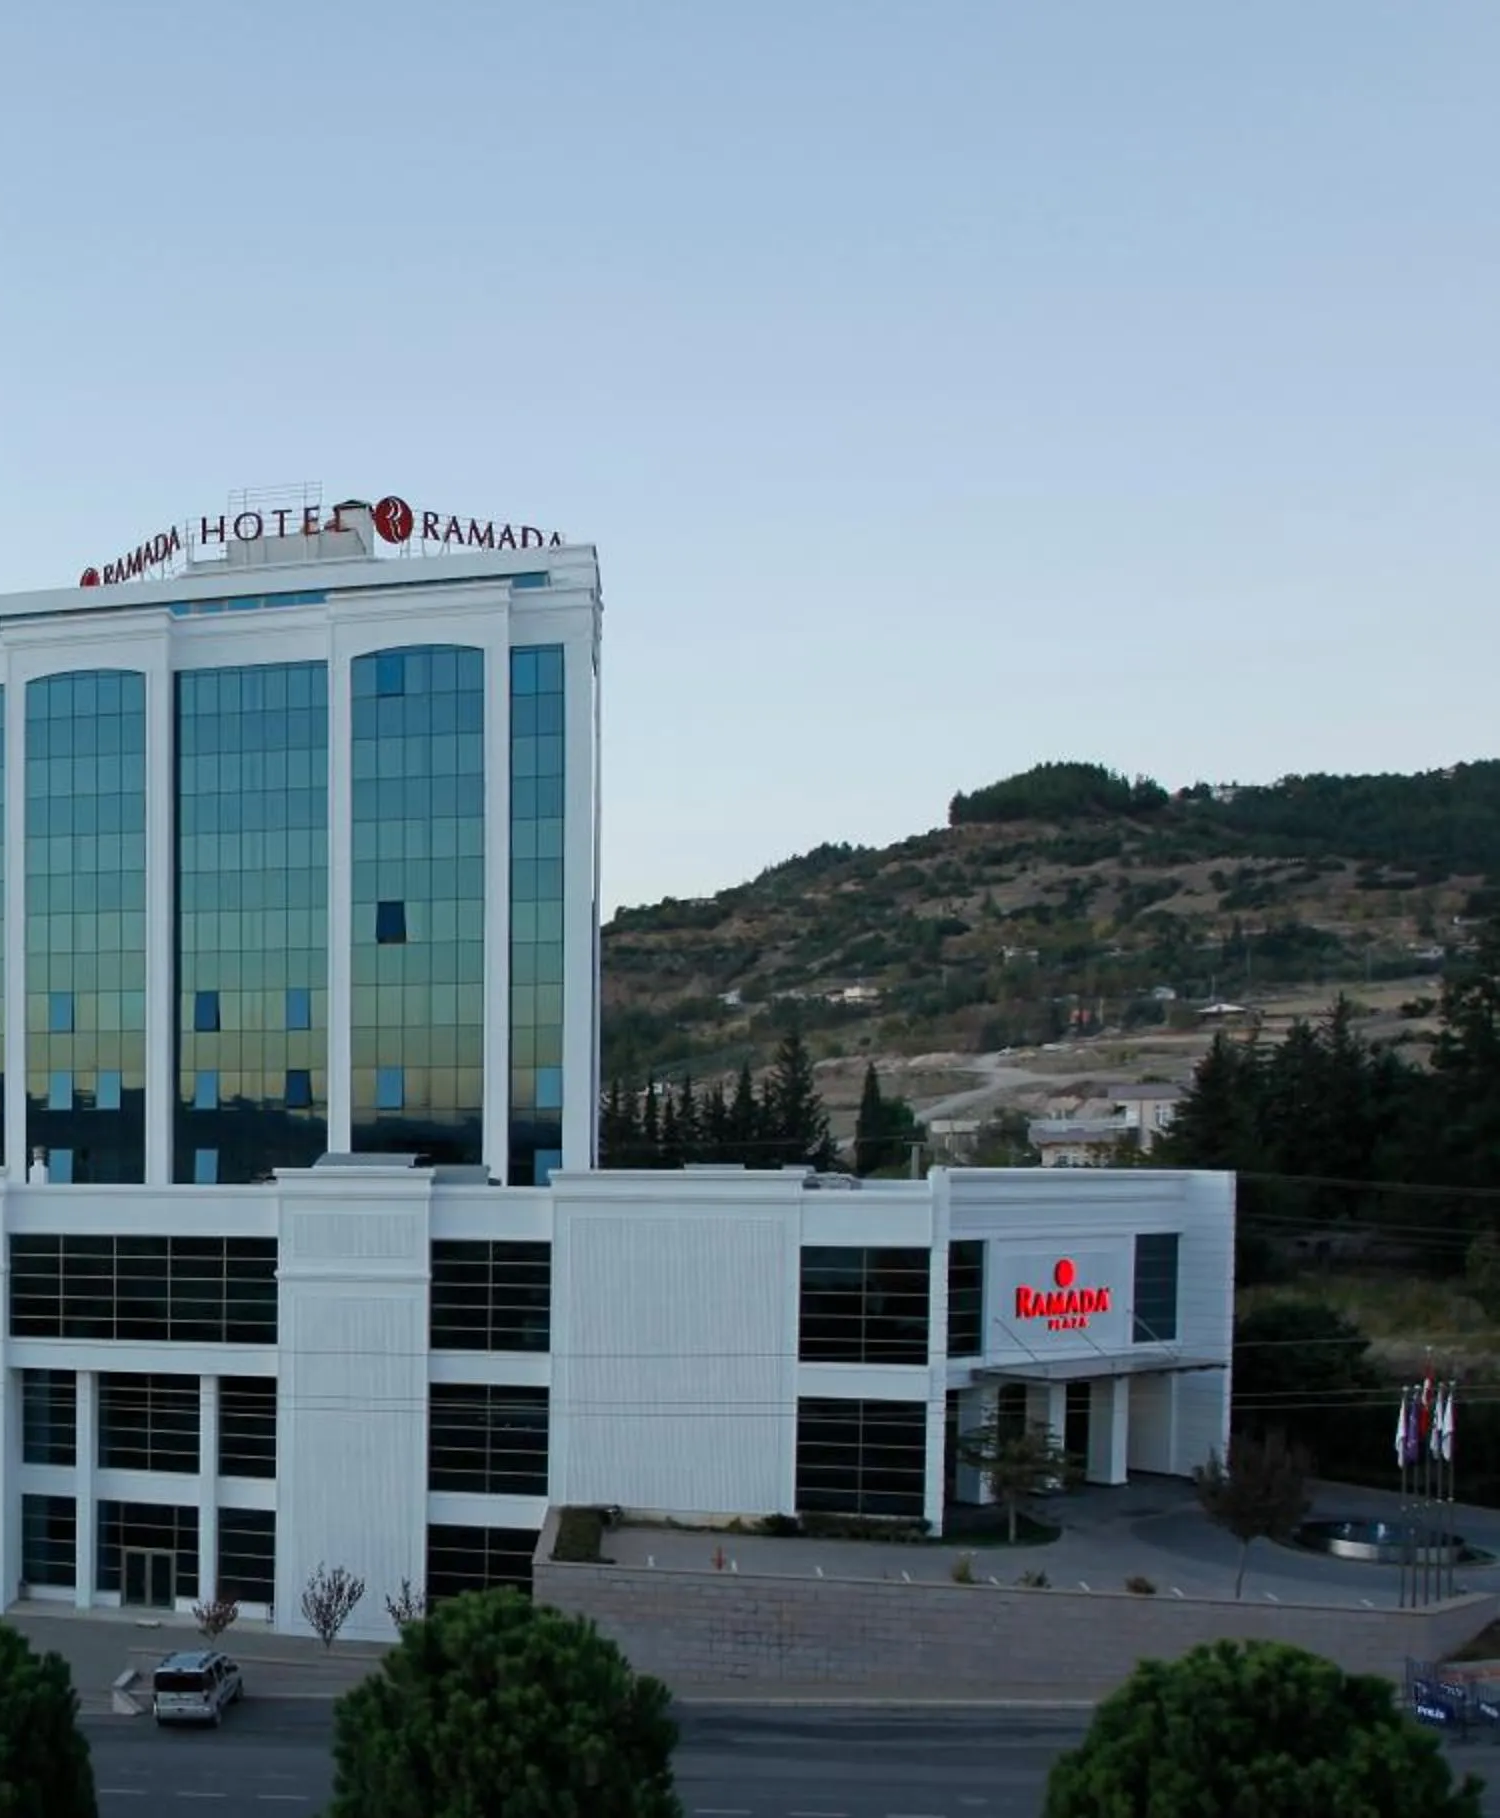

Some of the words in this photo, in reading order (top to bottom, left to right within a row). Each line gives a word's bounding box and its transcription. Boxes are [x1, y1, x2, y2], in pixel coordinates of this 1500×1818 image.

[201, 505, 352, 544] HOTEL
[103, 525, 180, 584] RAMADA
[1015, 1285, 1110, 1318] RAMADA
